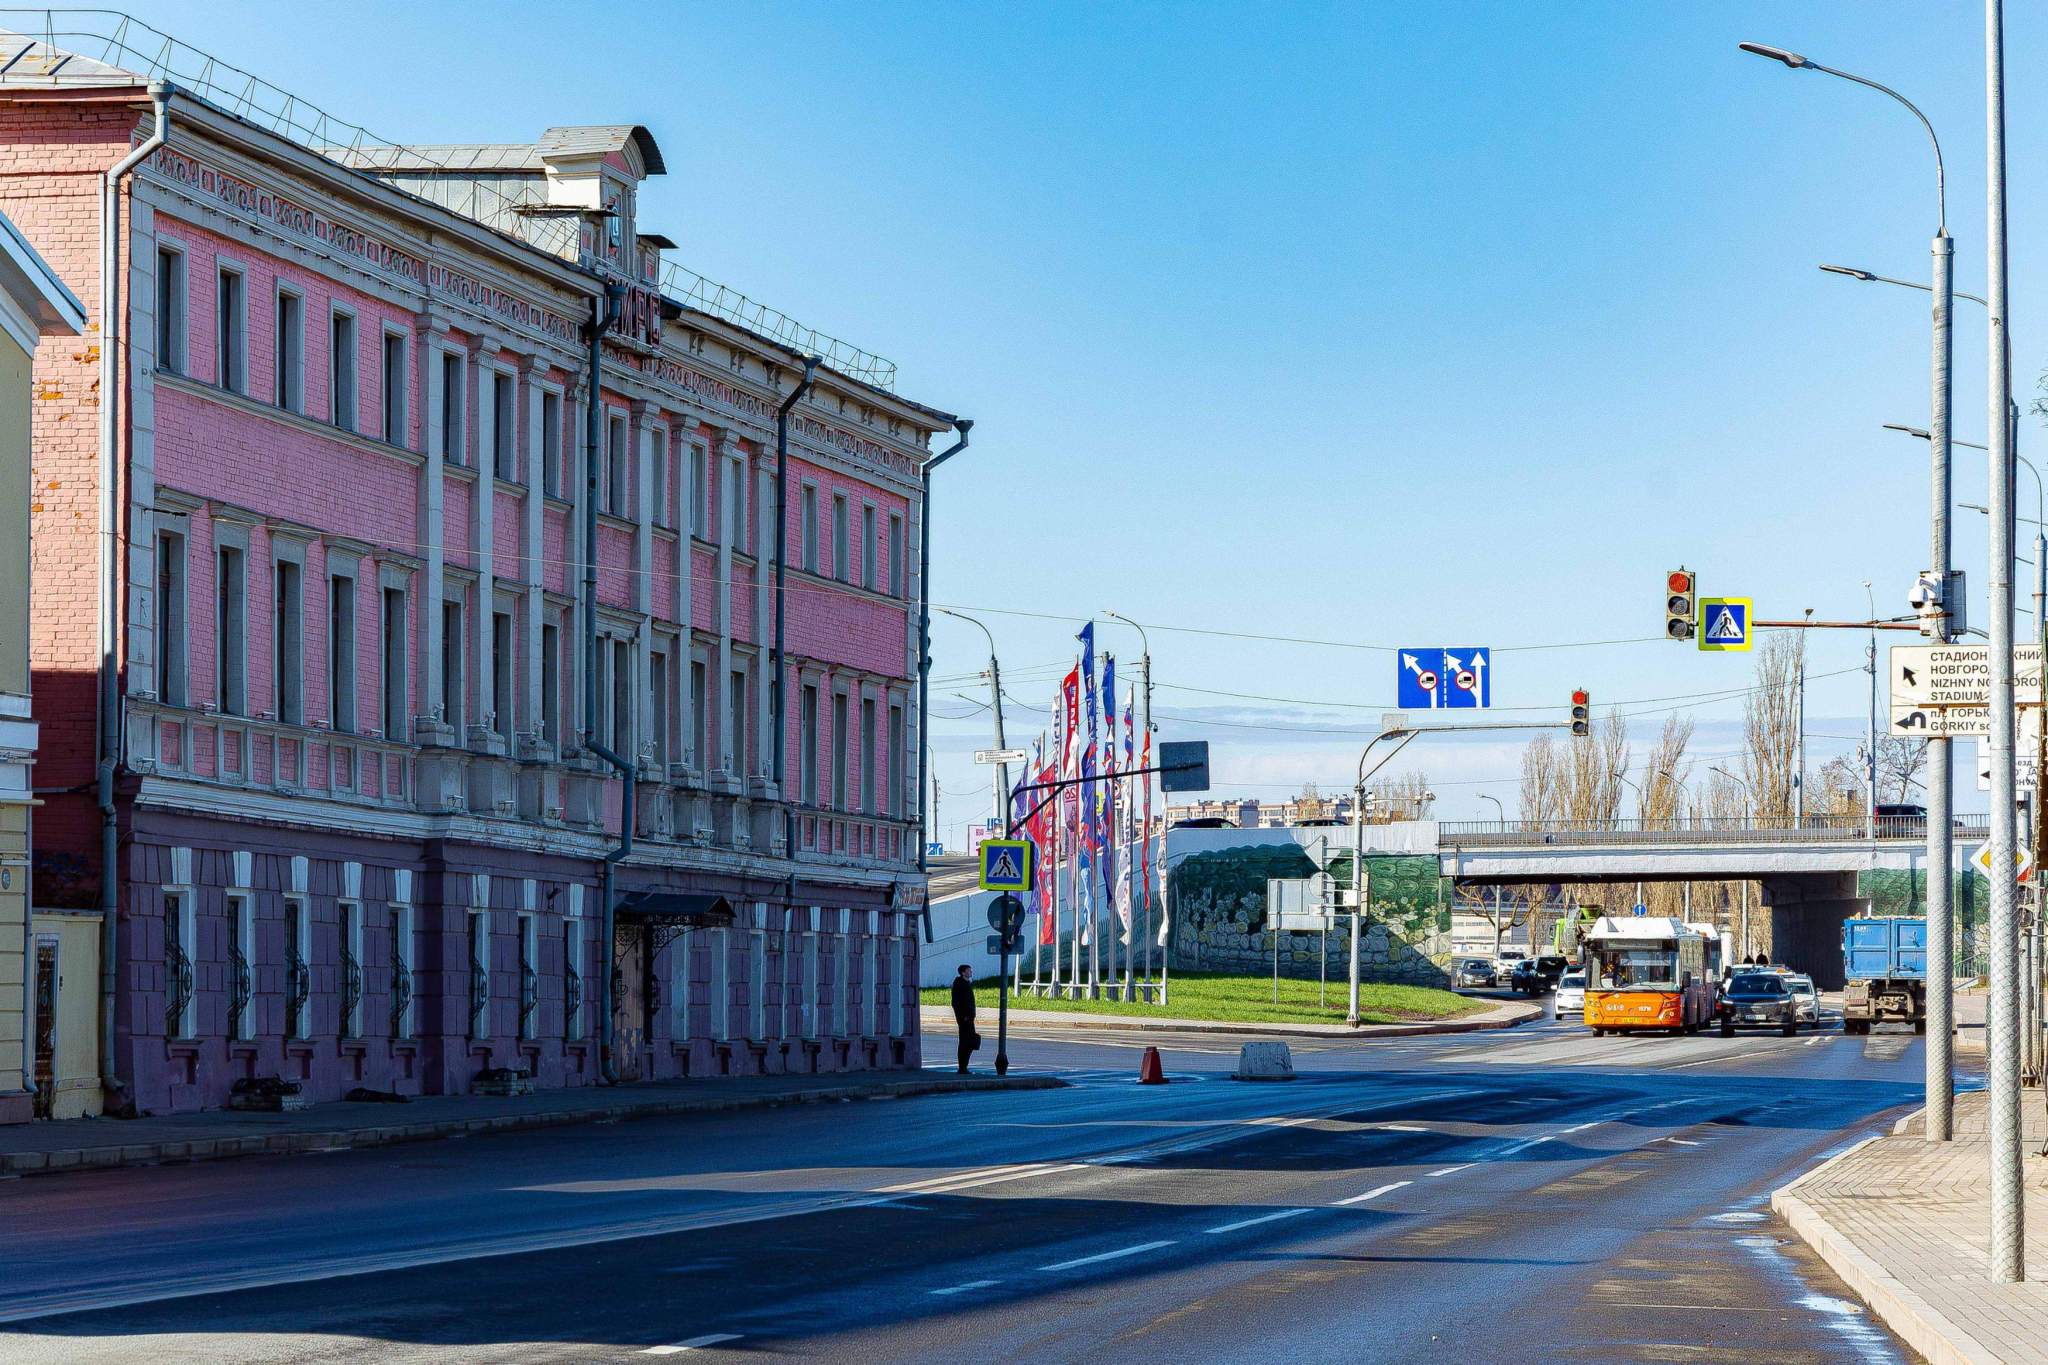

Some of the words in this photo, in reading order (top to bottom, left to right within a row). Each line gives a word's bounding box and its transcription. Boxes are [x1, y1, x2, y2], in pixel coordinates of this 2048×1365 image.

[1930, 651, 1988, 662] СТАДИОН
[1930, 664, 1990, 676] НОВГОРО
[1930, 678, 1973, 688] NIZHNY
[1930, 691, 1983, 701] STADIUM
[1951, 708, 1990, 718] ГОРЬК
[1930, 720, 1977, 731] GORKIY
